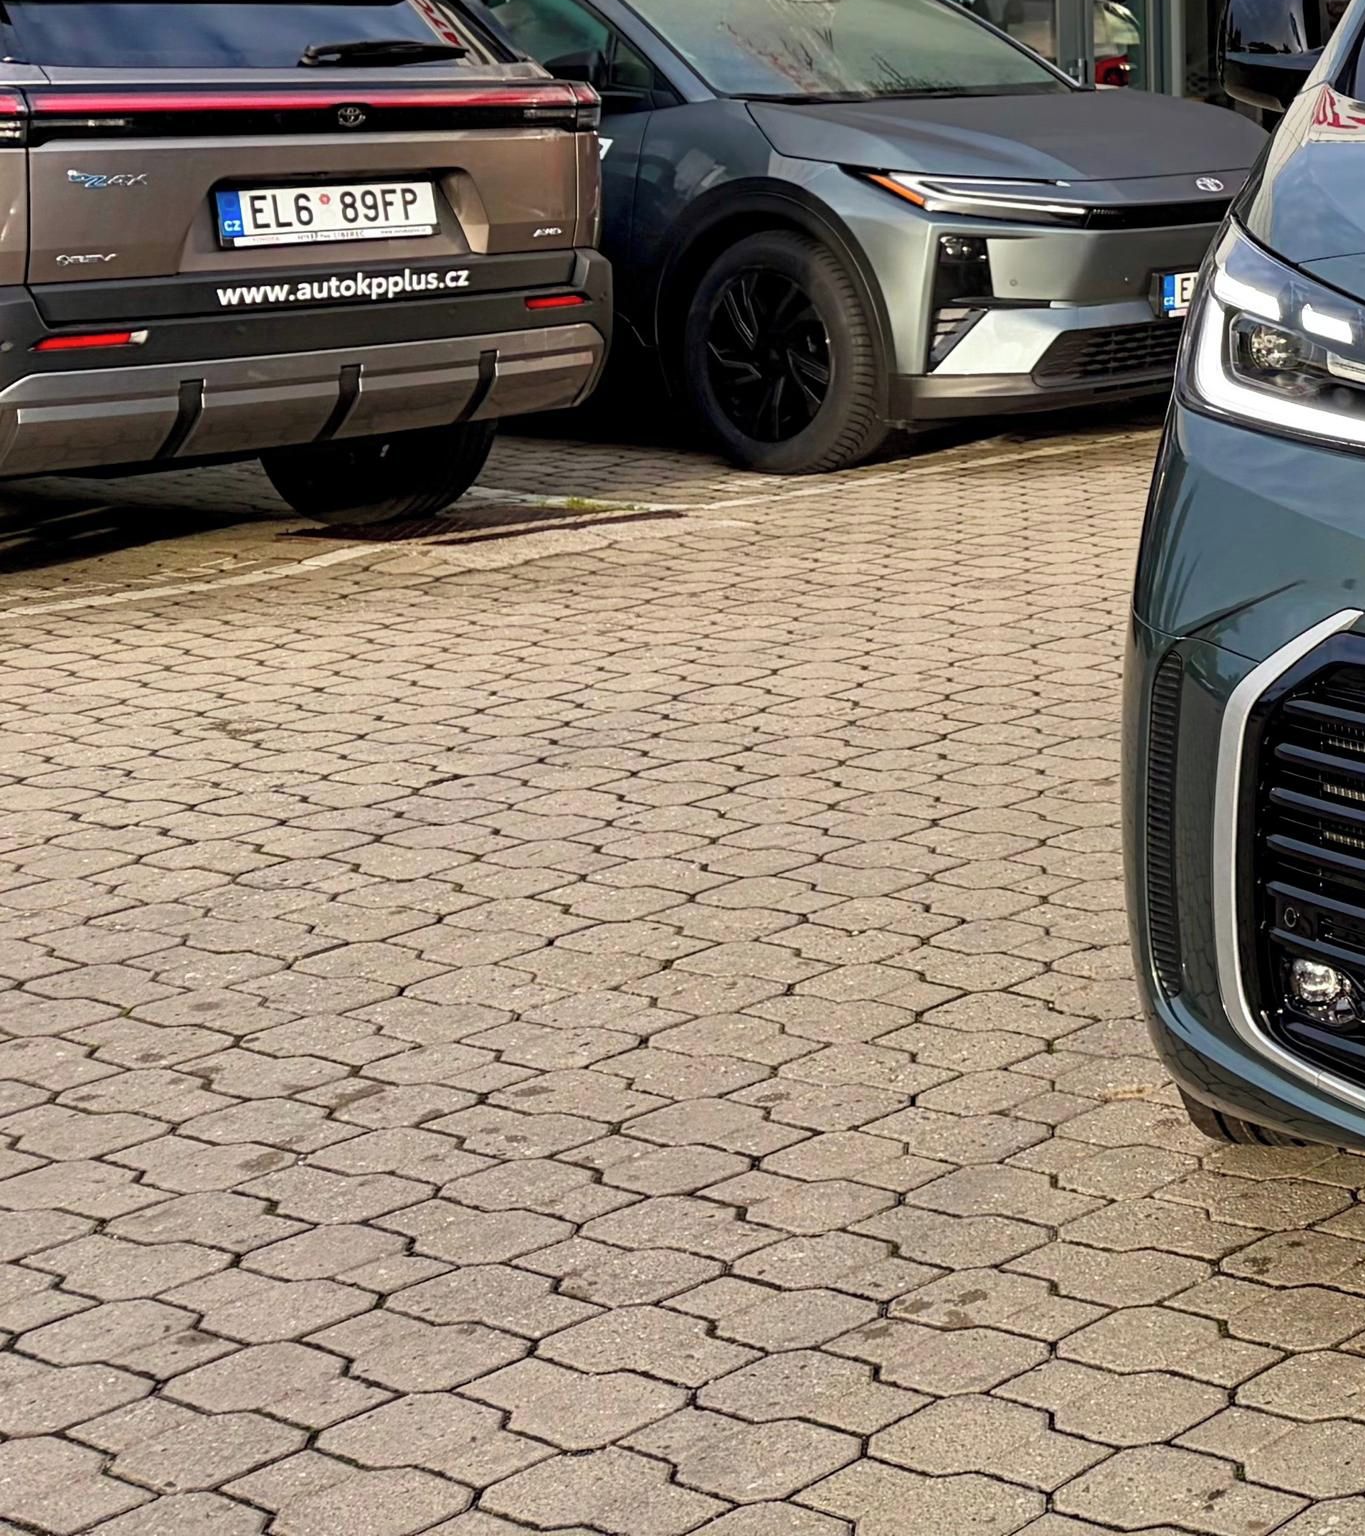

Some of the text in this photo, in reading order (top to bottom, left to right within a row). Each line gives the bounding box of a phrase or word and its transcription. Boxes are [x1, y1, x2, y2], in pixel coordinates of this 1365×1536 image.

[223, 219, 241, 232] CZ
[248, 187, 418, 229] EL6 89FP
[216, 268, 470, 306] www.autokpplus.cz
